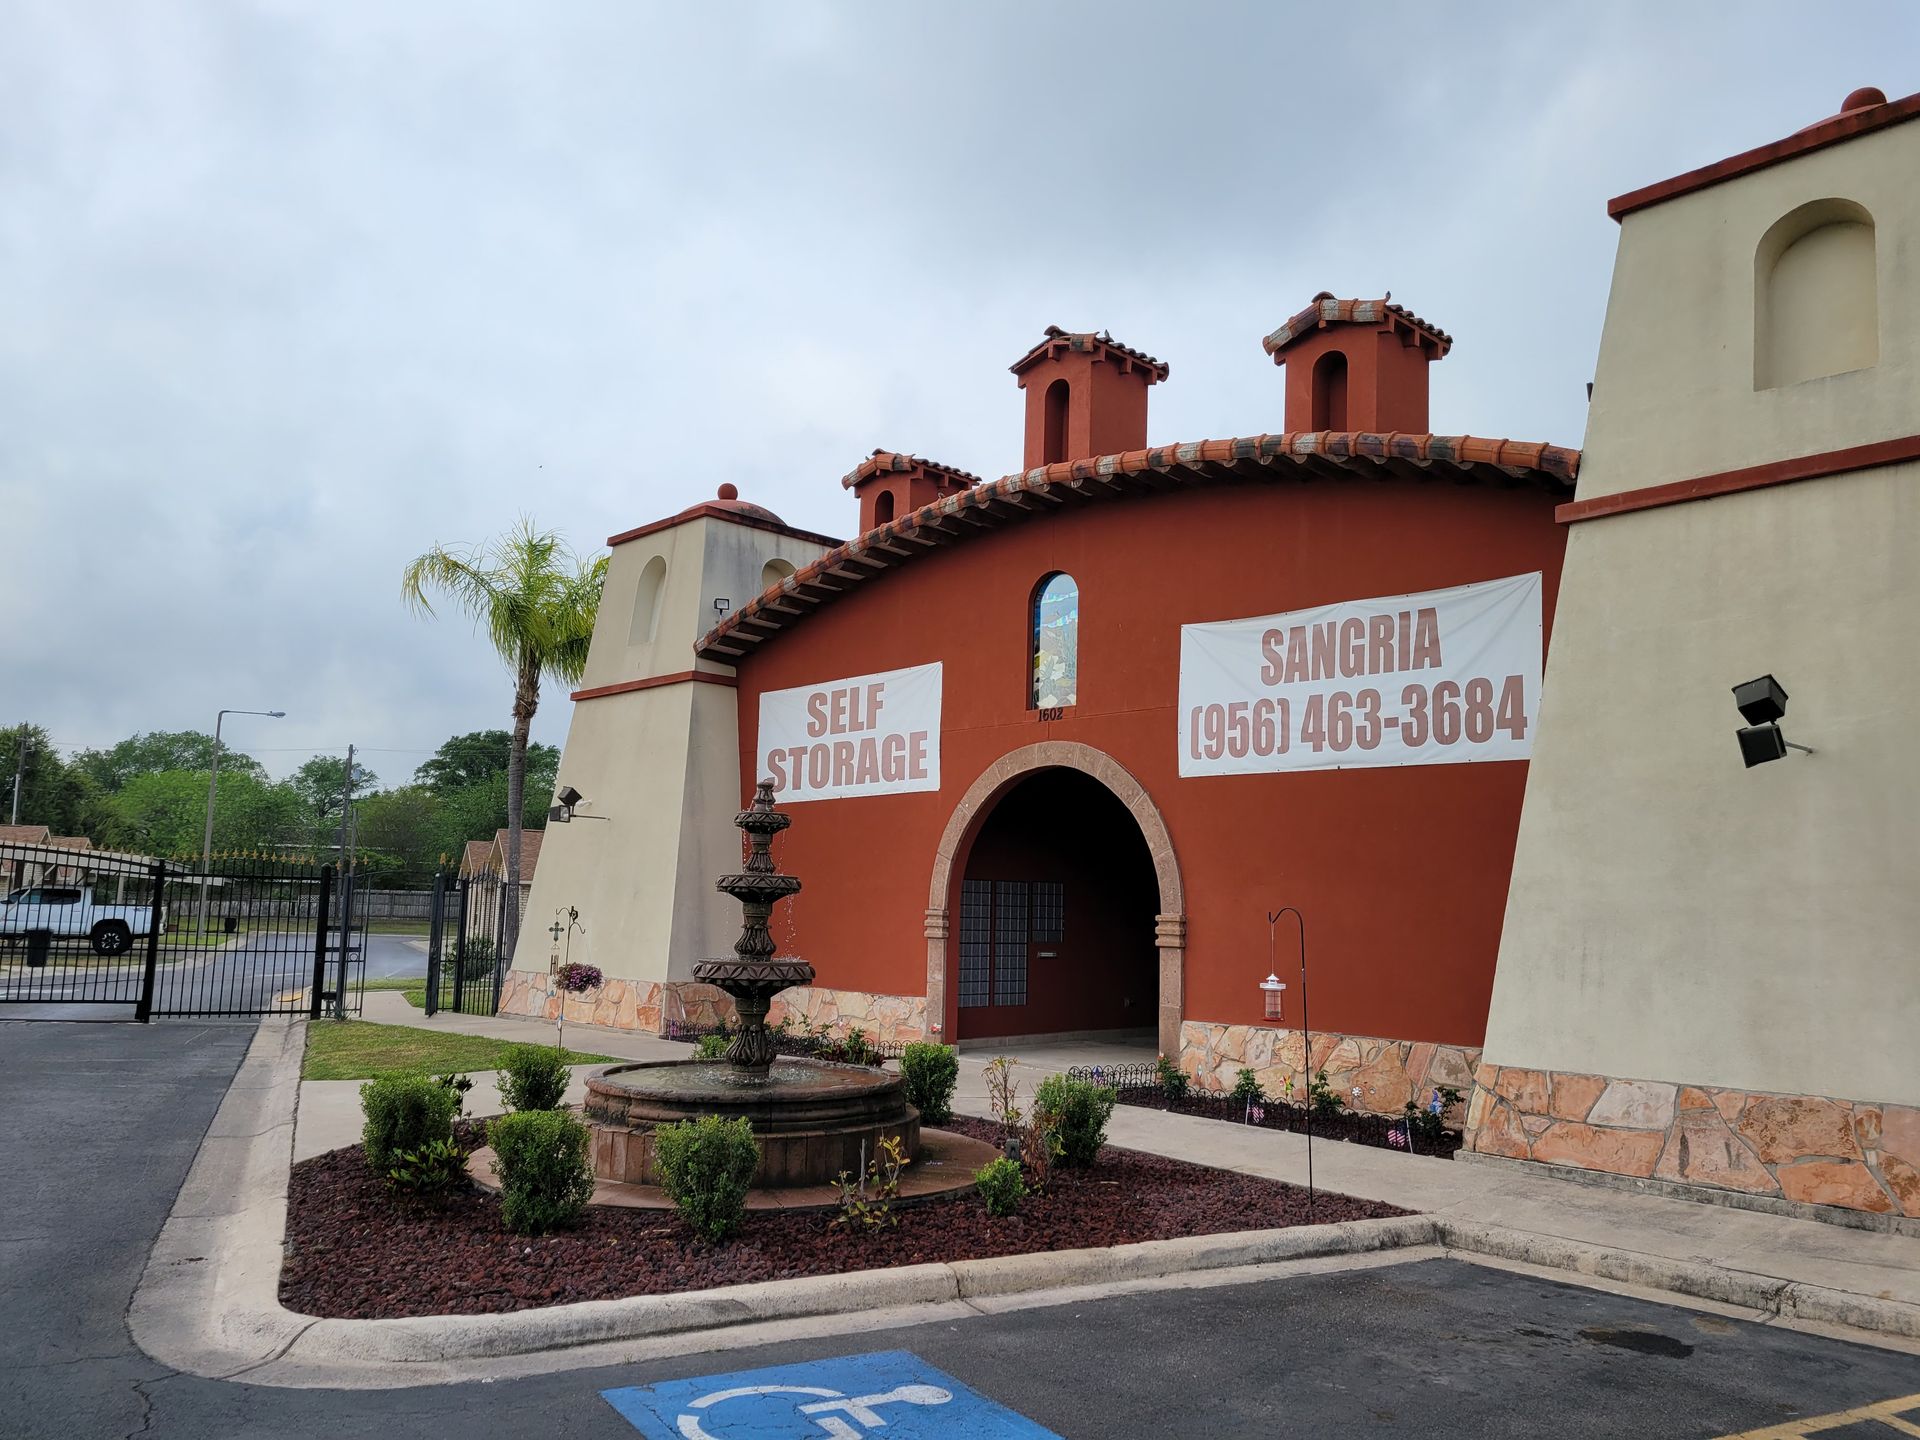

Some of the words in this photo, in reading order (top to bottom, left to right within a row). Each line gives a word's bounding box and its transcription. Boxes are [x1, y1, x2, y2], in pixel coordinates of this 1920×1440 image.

[1261, 607, 1442, 686] SANGRIA
[807, 683, 885, 738] SELF
[1039, 707, 1064, 722] 1602
[1301, 675, 1528, 753] 463-3684
[767, 731, 928, 793] STORAGE
